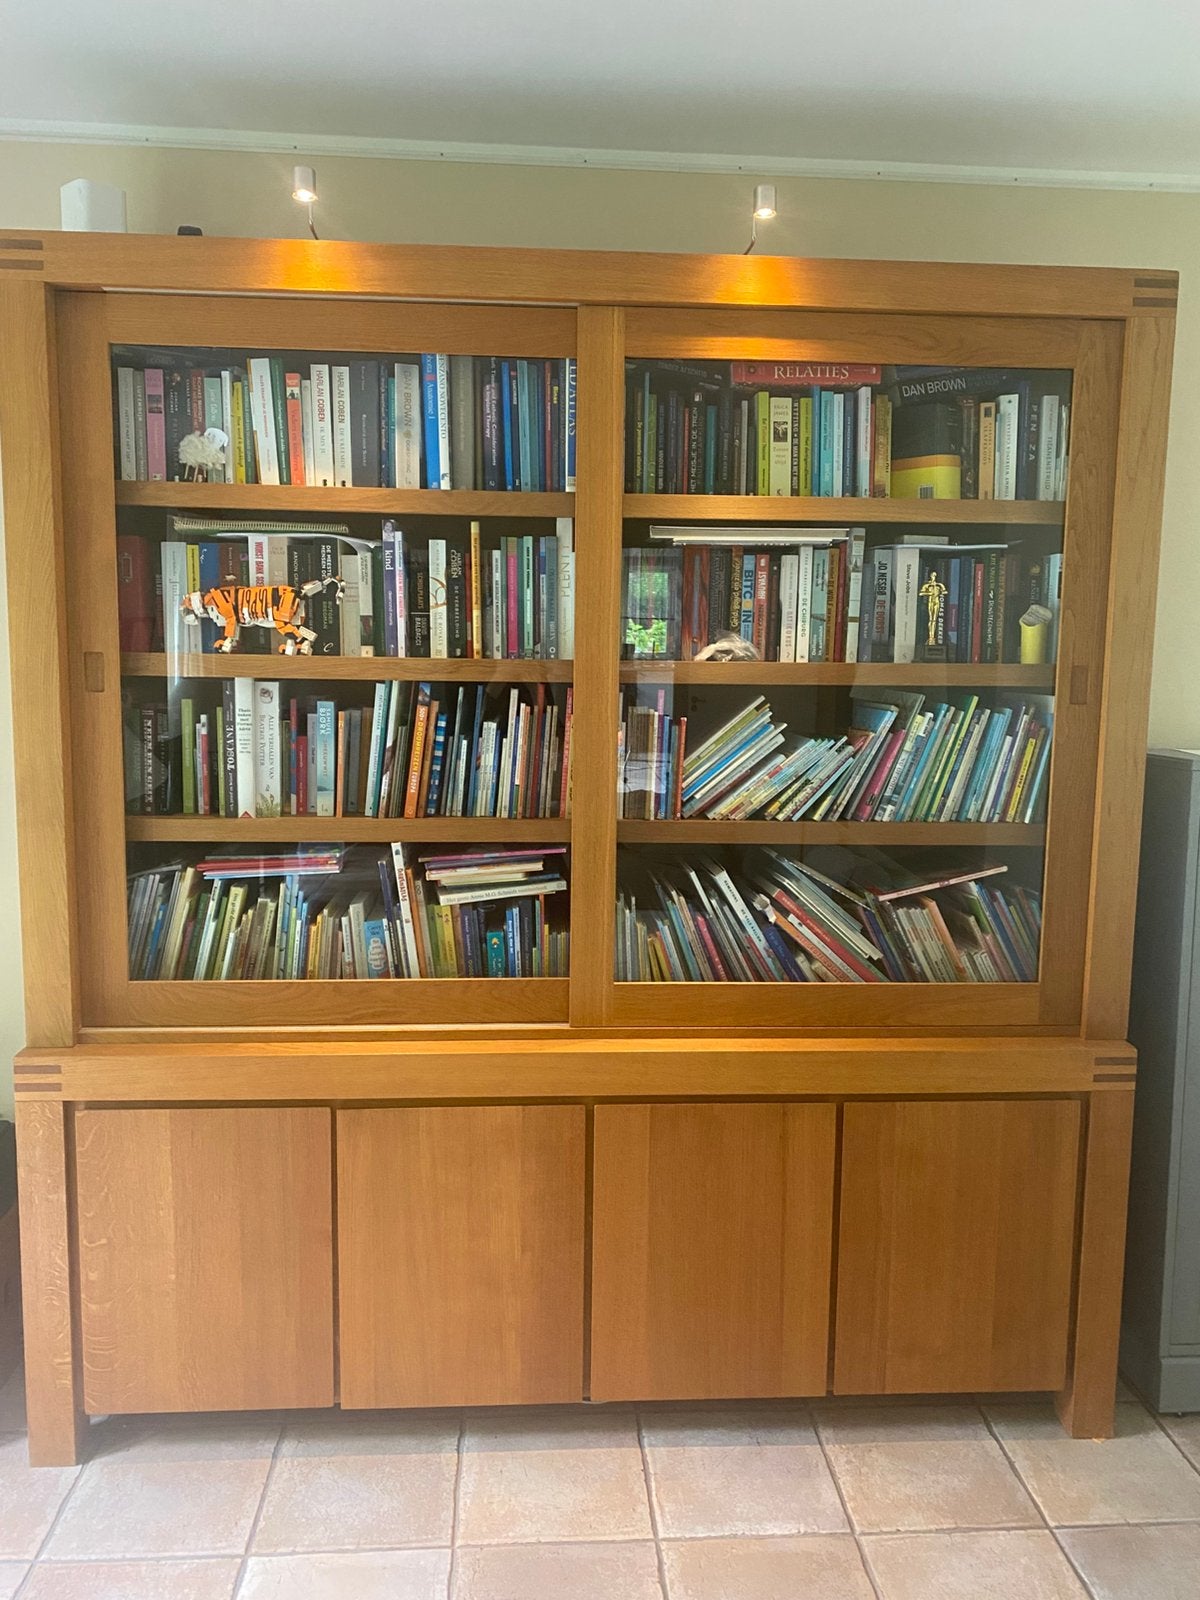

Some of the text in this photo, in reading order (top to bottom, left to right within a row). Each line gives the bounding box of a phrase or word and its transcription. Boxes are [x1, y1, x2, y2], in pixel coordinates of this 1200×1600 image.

[316, 370, 324, 396] HARLAN
[774, 365, 849, 380] RELATIES
[902, 378, 966, 397] DAN BROWN
[404, 392, 412, 427] BROWN
[439, 389, 447, 439] NOVECENTO
[1044, 436, 1053, 489] TITANENSTRIJD
[326, 545, 331, 553] DE
[385, 550, 394, 570] kind
[802, 598, 807, 606] DE
[875, 561, 887, 634] JO NESBØ DE DORST
[226, 725, 235, 770] TOSCANE
[413, 722, 424, 770] DROOMREIZEN
